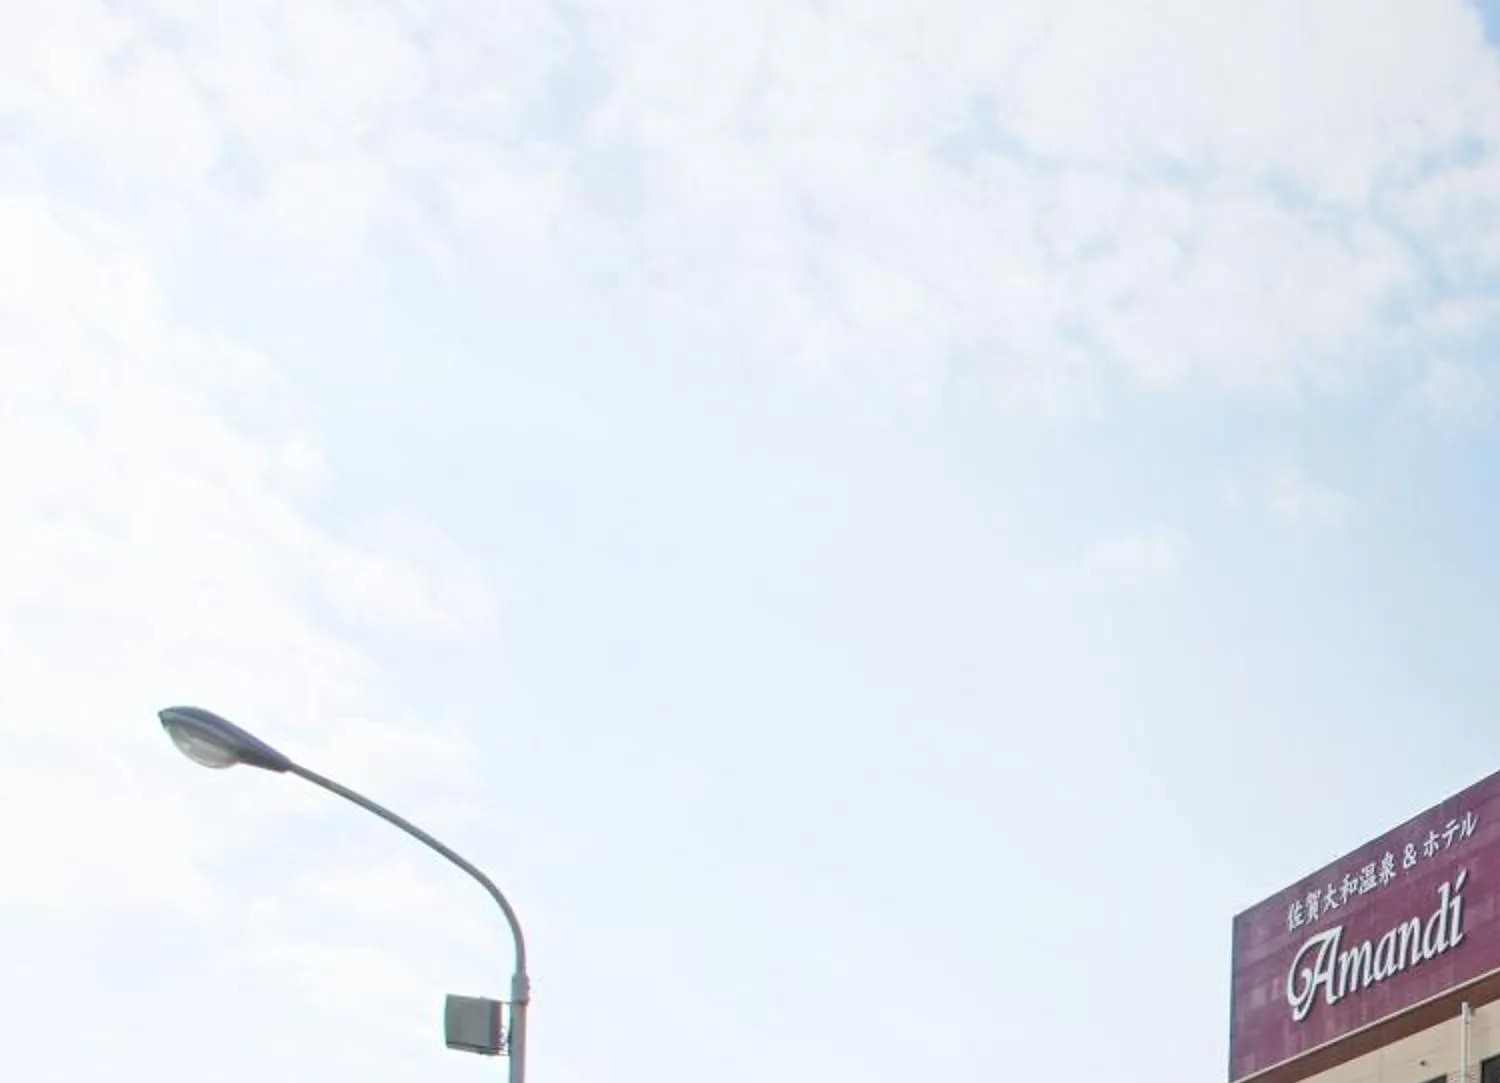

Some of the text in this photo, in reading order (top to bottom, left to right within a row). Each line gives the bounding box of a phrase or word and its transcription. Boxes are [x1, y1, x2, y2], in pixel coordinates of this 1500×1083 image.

[1288, 811, 1479, 932] 佐賀大和温泉 & ホテル
